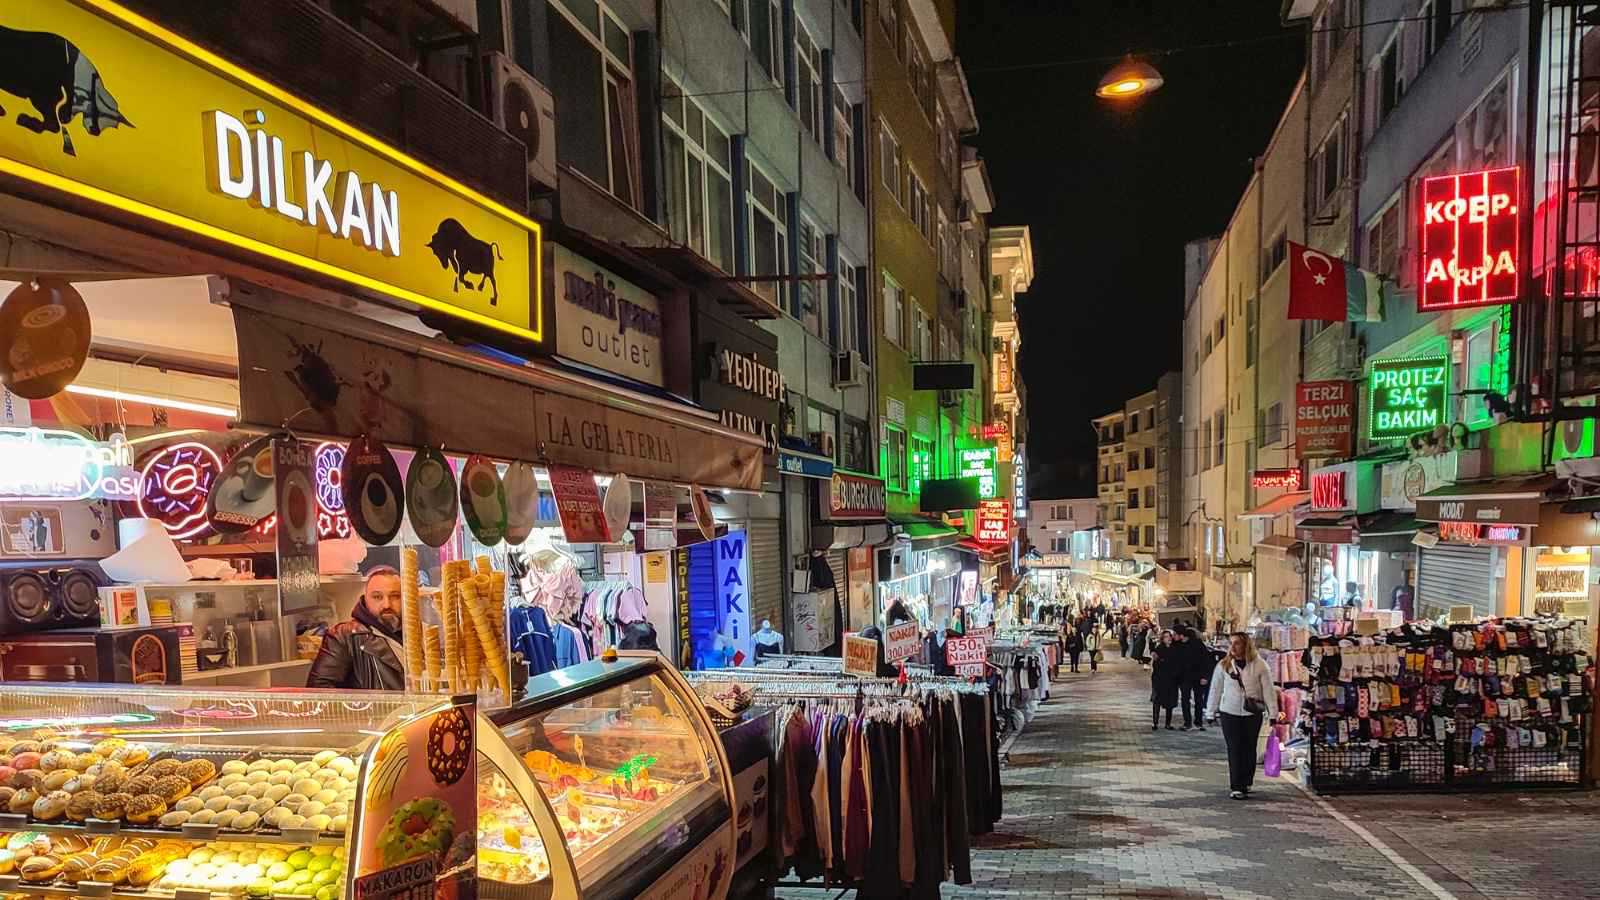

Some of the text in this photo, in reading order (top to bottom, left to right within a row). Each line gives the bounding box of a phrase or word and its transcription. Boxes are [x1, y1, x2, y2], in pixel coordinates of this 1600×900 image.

[214, 109, 400, 257] DİLKAN
[582, 325, 651, 368] outlet
[724, 348, 786, 404] YEDİTEPE
[1373, 367, 1445, 389] PROTEZ
[1303, 383, 1345, 401] TERZİ
[1388, 387, 1428, 408] SAÇ
[1298, 404, 1350, 422] SELÇUK
[1377, 409, 1437, 430] BAKIM
[547, 412, 673, 463] LA GELATERIA
[840, 480, 885, 511] BURGER KING
[359, 860, 433, 894] MAKARON
